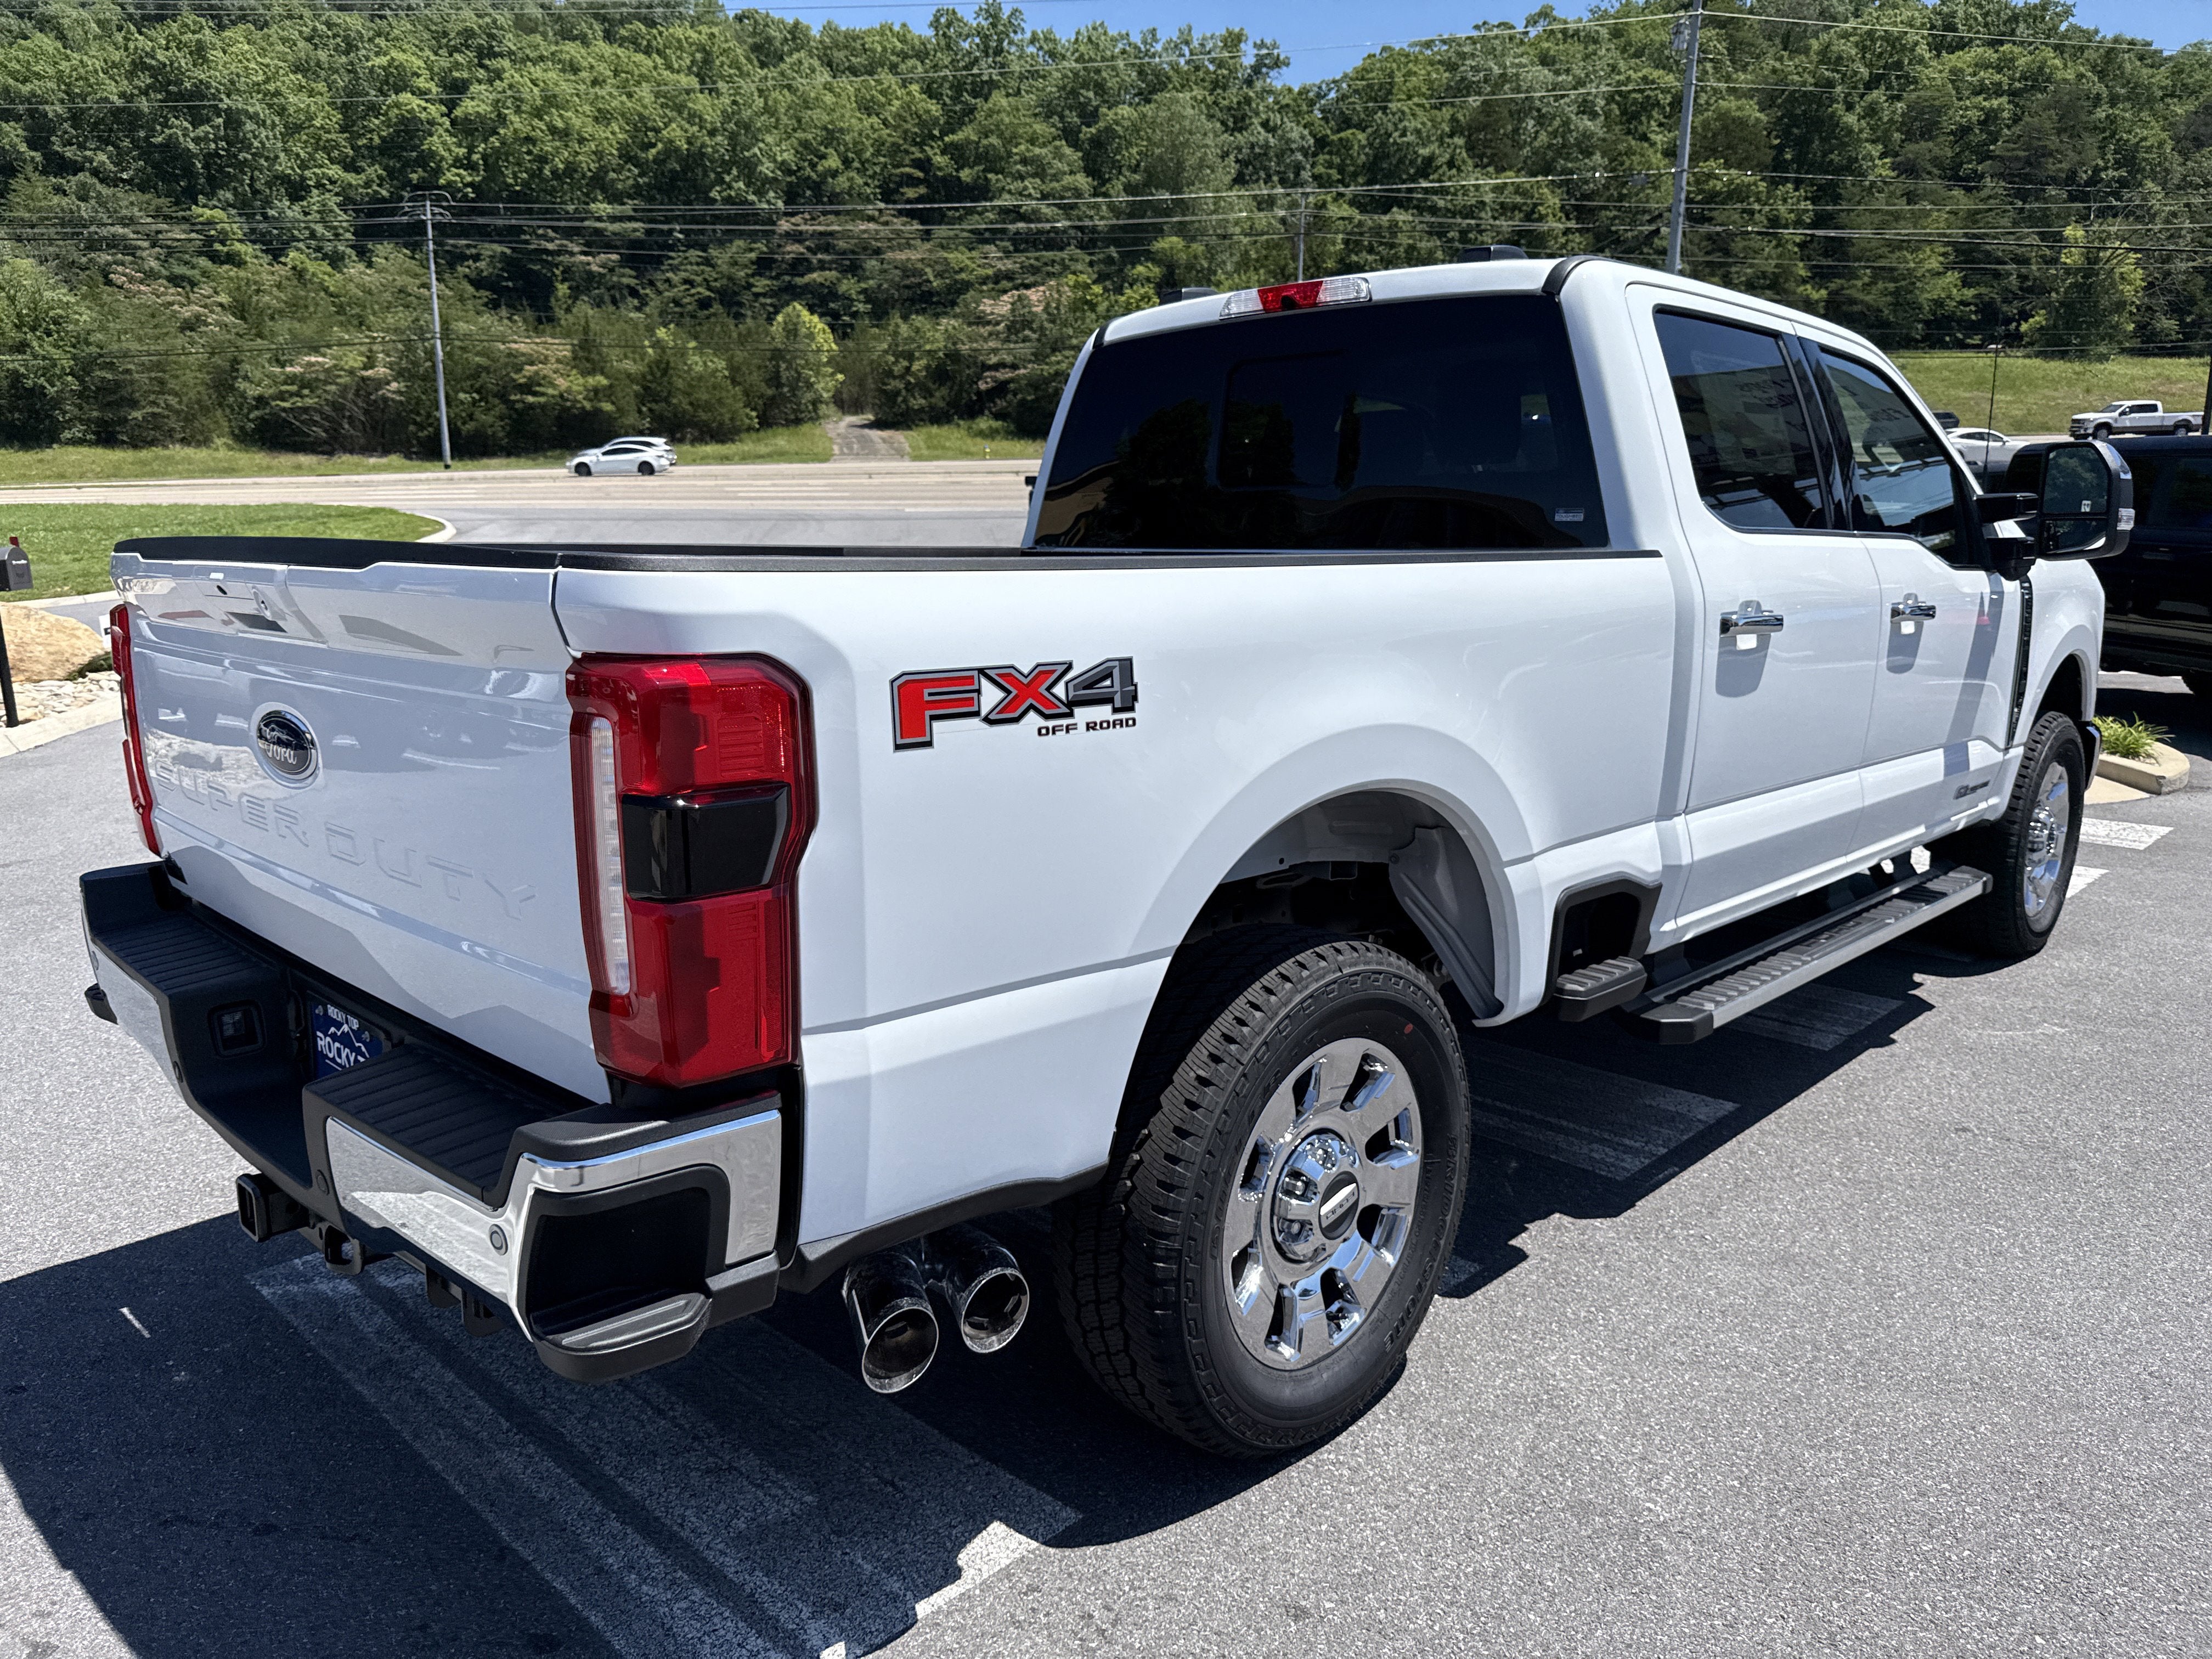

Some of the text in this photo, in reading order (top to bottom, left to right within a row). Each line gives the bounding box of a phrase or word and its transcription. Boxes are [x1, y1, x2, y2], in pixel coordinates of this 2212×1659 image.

[889, 656, 1139, 752] FX4
[264, 724, 297, 765] Ford
[1037, 716, 1137, 737] OFF ROAD
[155, 759, 537, 921] SUPER DUTY
[327, 1004, 359, 1031] ROCKY TOP
[316, 1031, 356, 1068] ROCKY
